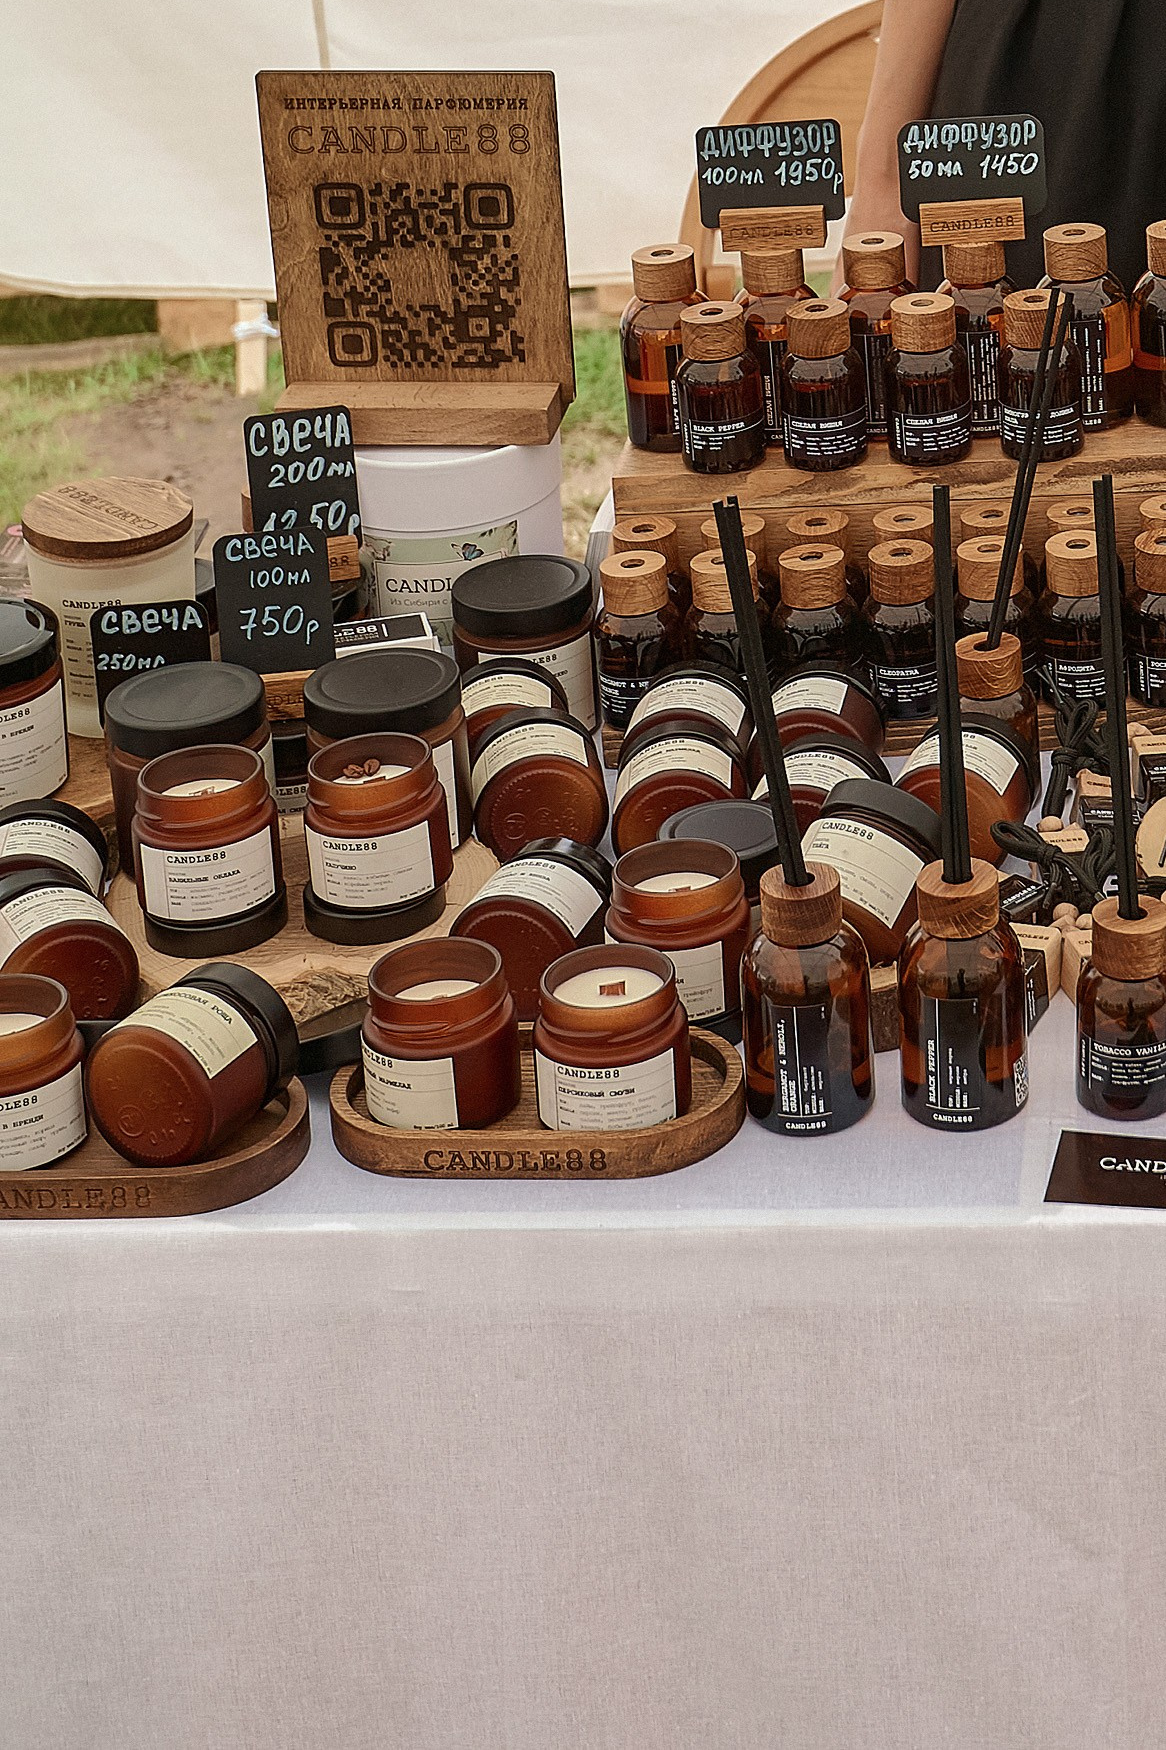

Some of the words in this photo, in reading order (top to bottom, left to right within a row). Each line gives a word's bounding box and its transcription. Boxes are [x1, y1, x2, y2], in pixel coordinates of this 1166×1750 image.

[284, 98, 401, 111] ИНТЕРЬЕРНАЯ
[412, 97, 529, 111] ПАРФЮМЕРИЯ
[288, 123, 531, 155] CANDLE88
[700, 123, 836, 161] ДИФФУЗОР
[903, 119, 1037, 154] ДИФФУЗОР
[979, 152, 1039, 179] 1450
[930, 216, 1015, 233] CANDLE88
[693, 424, 715, 432] BLACK
[718, 421, 745, 432] PEPPER
[404, 598, 441, 607] Сибири
[238, 605, 320, 644] 750р
[879, 668, 919, 676] CLEOPATRA
[12, 820, 70, 834] CANDLE88
[822, 821, 874, 841] CANDLE88
[322, 840, 378, 851] CANDLE88
[166, 851, 227, 864] CANDLE88
[5, 890, 64, 913] CANDLE88
[211, 1004, 233, 1025] РОЩА
[927, 1039, 935, 1074] PEPPER
[1093, 1042, 1131, 1056] TOBACCO
[557, 1066, 620, 1080] CANDLE88
[780, 1068, 789, 1112] BERGAMOT
[789, 1080, 798, 1112] ORANGE
[928, 1076, 936, 1103] BLACK
[785, 1121, 827, 1130] CANDLE88
[933, 1113, 973, 1123] CANDLE88
[424, 1149, 607, 1171] CANDLE88
[0, 1185, 151, 1209] ANDLE88
